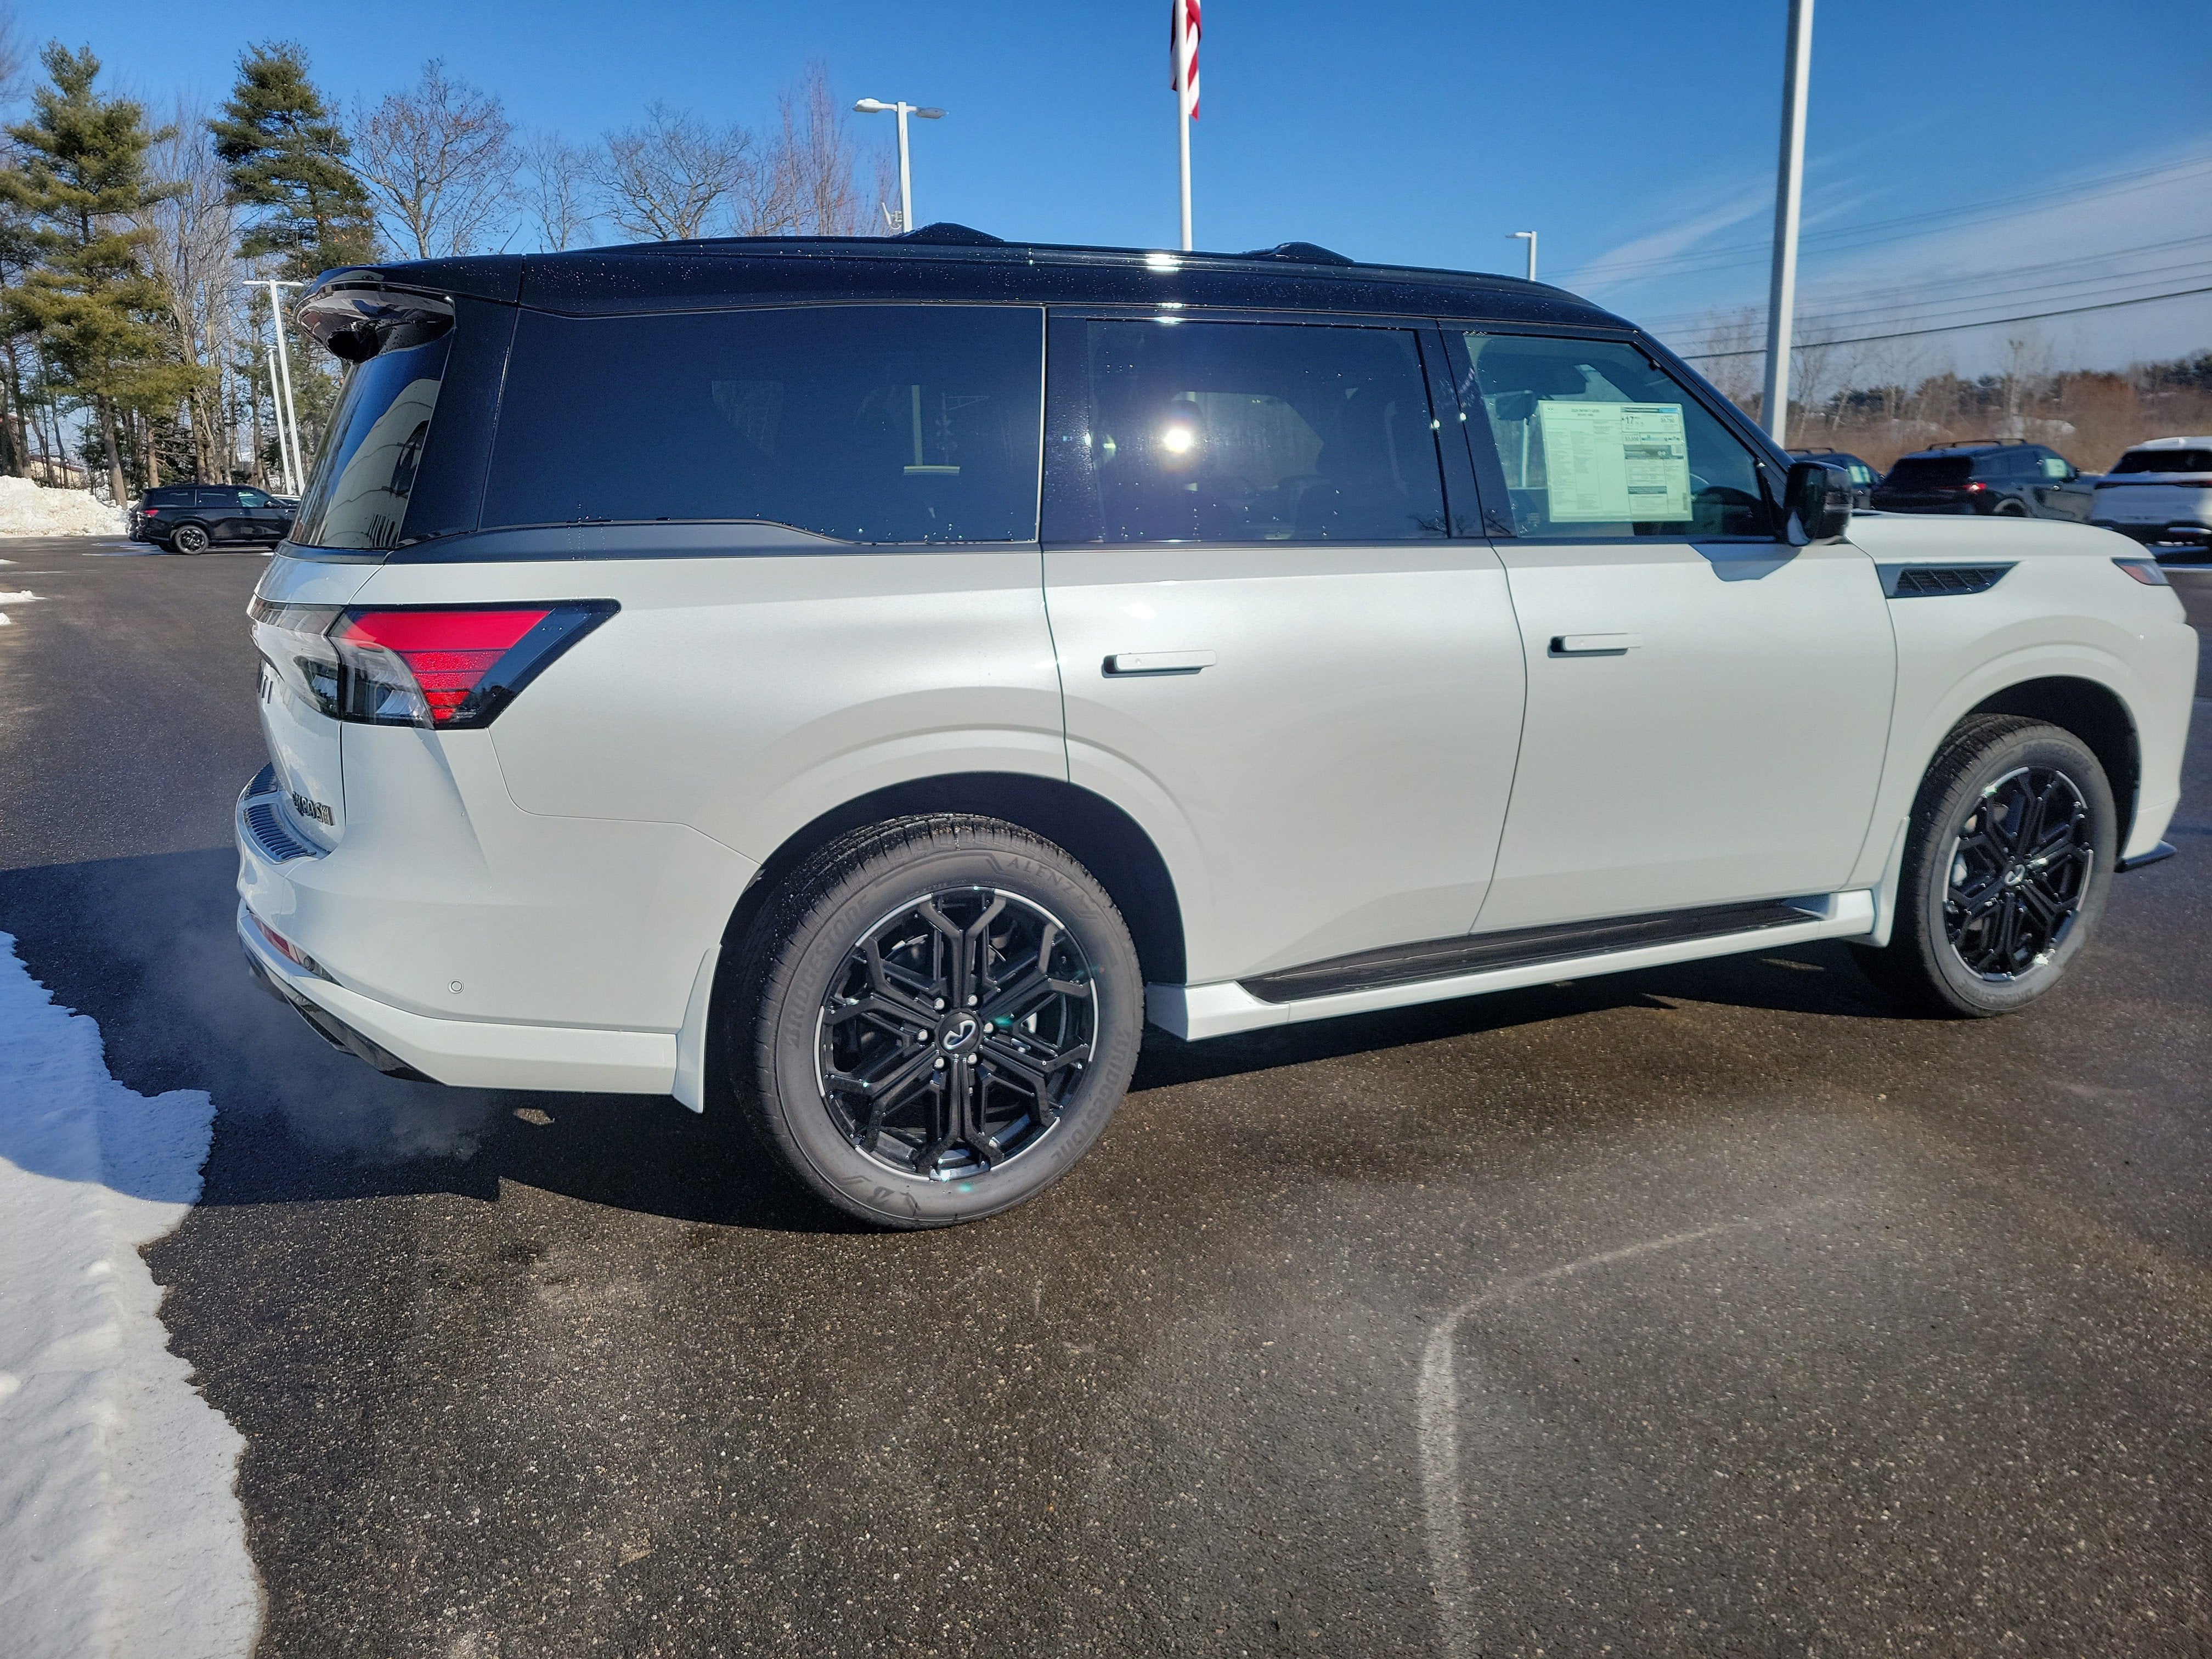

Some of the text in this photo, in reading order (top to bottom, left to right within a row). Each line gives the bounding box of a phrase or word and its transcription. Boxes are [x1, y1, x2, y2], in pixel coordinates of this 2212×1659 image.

[1007, 857, 1092, 911] ALENZA
[784, 893, 871, 1048] BRIDGESTONE
[1051, 1030, 1132, 1161] BRIDGESTONE
